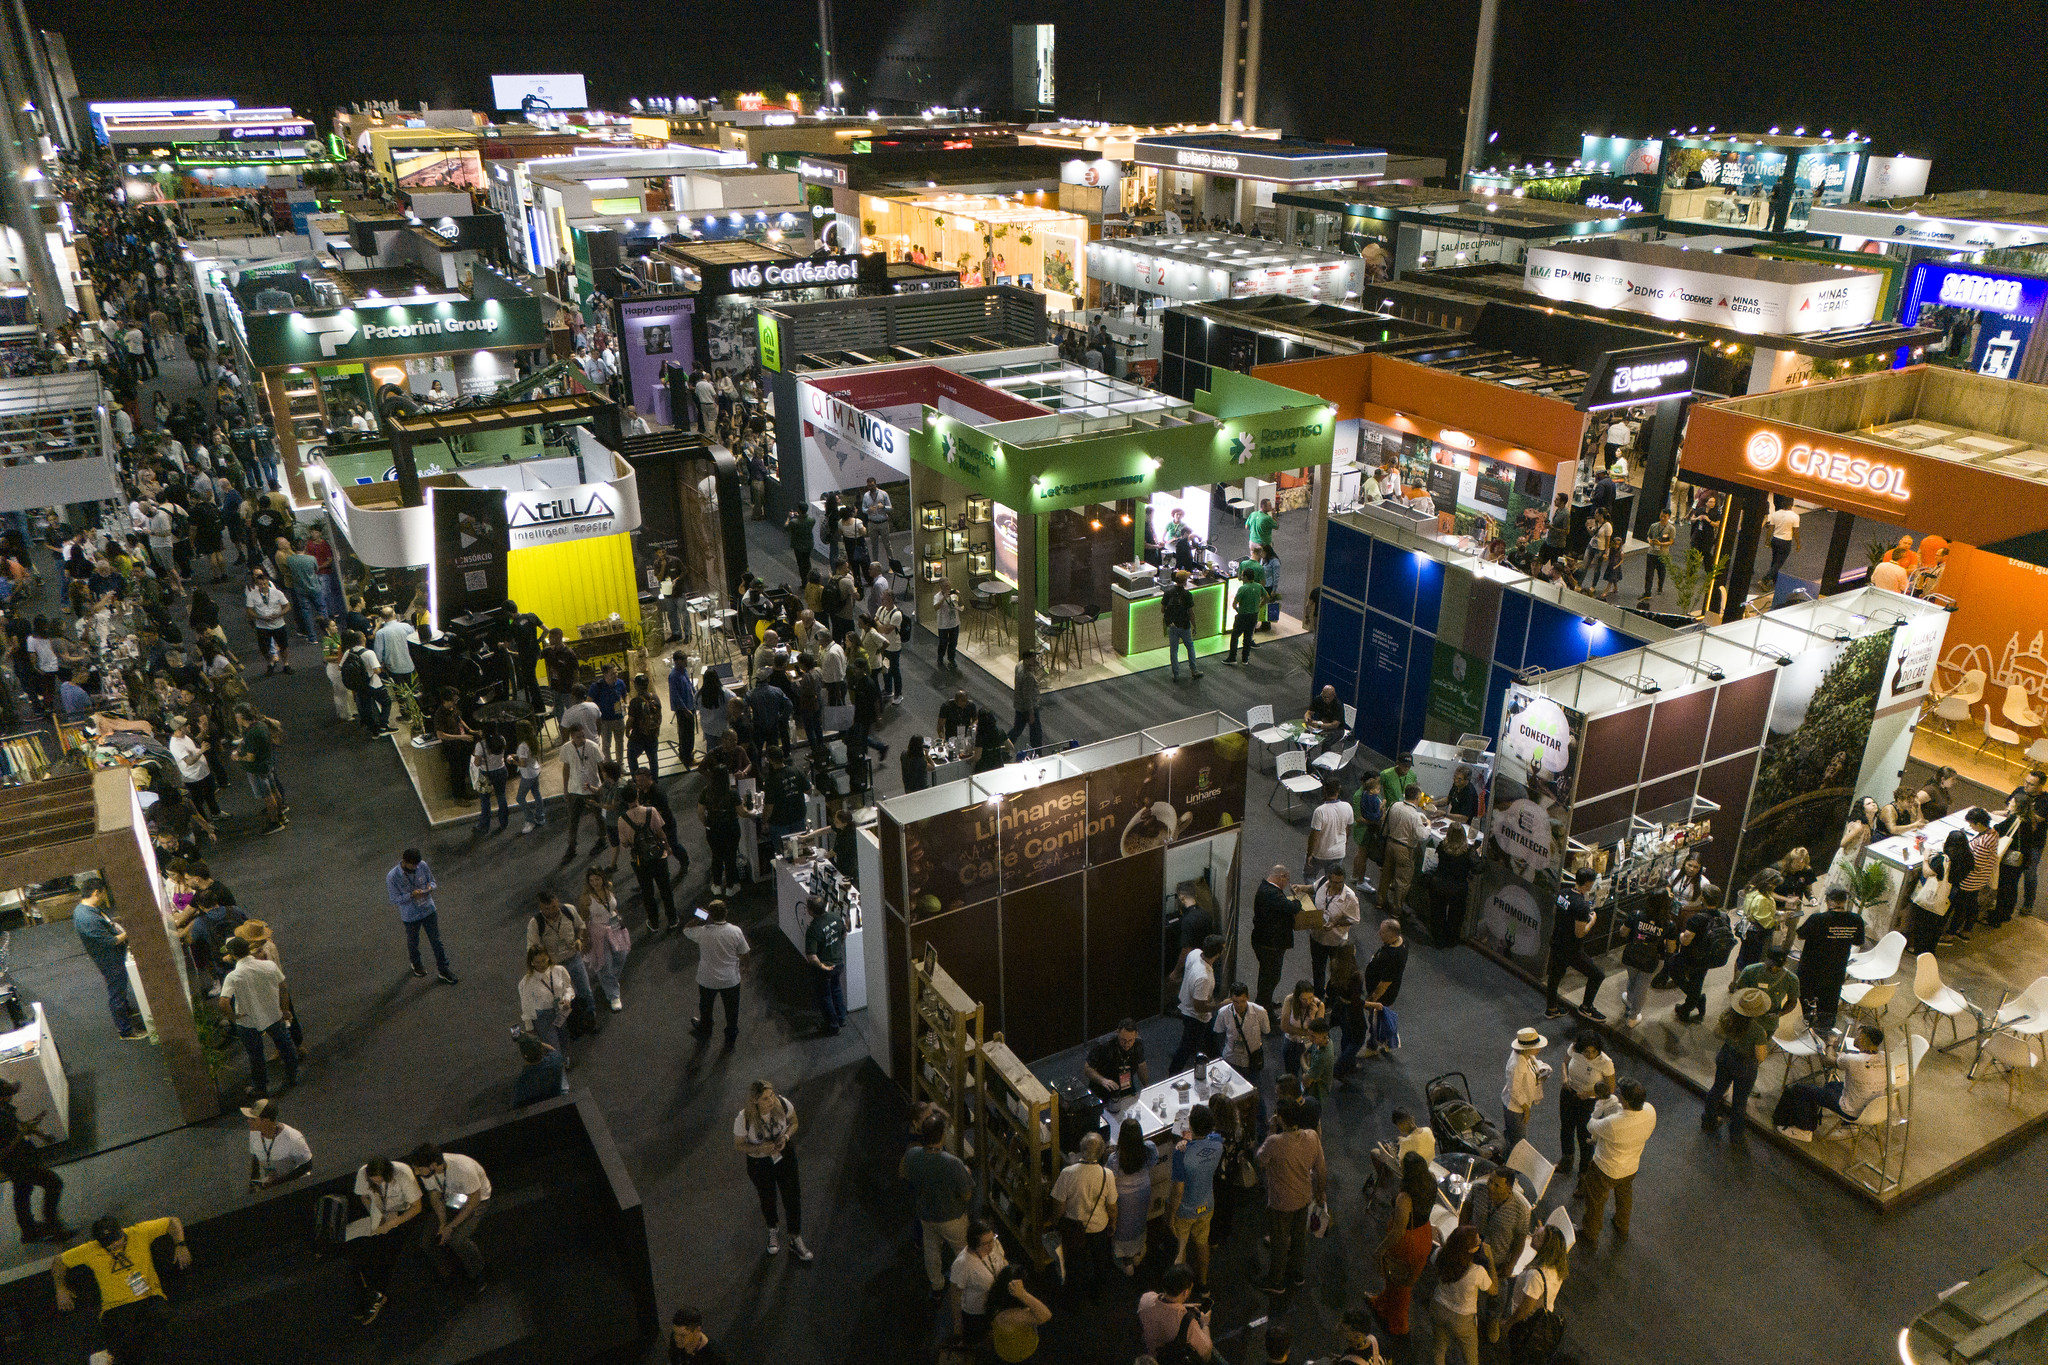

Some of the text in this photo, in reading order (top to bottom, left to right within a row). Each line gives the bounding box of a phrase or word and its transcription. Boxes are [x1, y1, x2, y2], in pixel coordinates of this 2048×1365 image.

[1211, 155, 1239, 170] SANTO
[1440, 239, 1501, 253] SALA DE CUPPING
[731, 259, 860, 289] Nó Cafézão!
[1157, 267, 1166, 286] 2
[1554, 268, 1592, 283] EPAMIG
[1633, 285, 1664, 299] BDMG
[1680, 293, 1714, 306] CODEMGE
[1818, 288, 1848, 300] MINAS
[1941, 274, 2021, 309] SATAKE
[1731, 304, 1761, 315] GERAIS
[1732, 296, 1759, 306] MINAS
[1816, 300, 1849, 313] GERAIS
[624, 302, 693, 318] Happy Cupping
[363, 318, 499, 340] Pacorini Group
[1261, 422, 1323, 443] Rovensa
[1260, 442, 1297, 460] Next
[1787, 444, 1911, 500] CRESOL
[513, 520, 613, 541] Intelligent Roaster
[2008, 558, 2035, 571] trem
[1901, 668, 1913, 683] DO
[1519, 723, 1562, 752] CONECTAR
[1186, 787, 1222, 805] Linhares
[975, 789, 1087, 842] Linhares
[959, 813, 1115, 885] Café Conilon
[1500, 823, 1549, 859] FORTALECER
[1493, 895, 1539, 931] PROMOVER
[1637, 920, 1664, 937] BLUM'S
[1196, 1205, 1208, 1215] BH
